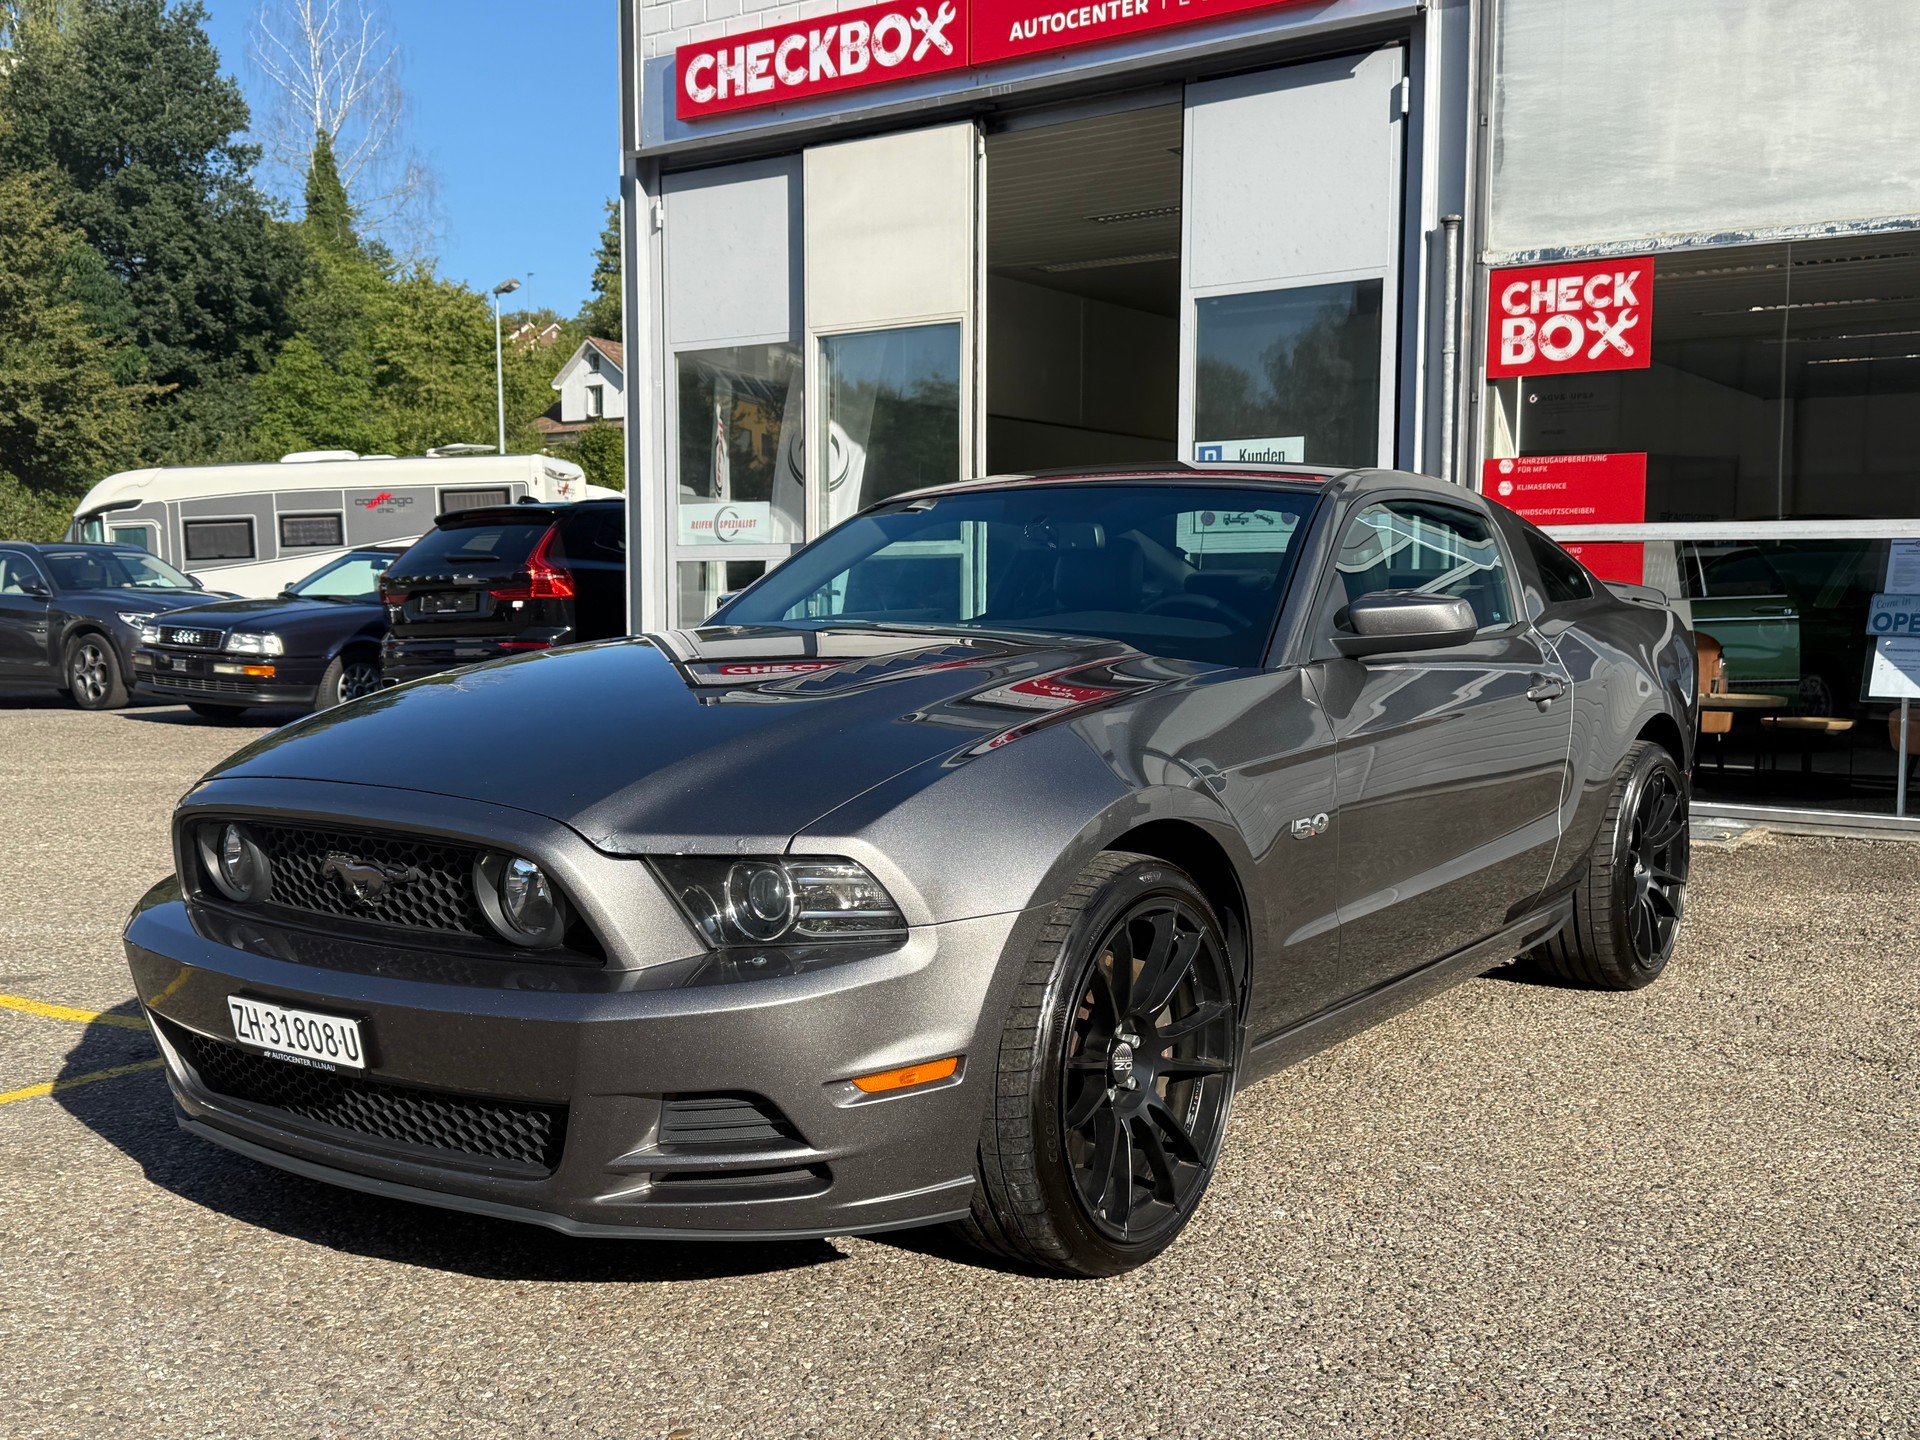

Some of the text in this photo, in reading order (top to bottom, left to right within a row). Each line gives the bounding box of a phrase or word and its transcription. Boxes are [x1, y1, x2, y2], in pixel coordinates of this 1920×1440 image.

[1008, 0, 1149, 41] AUTOCENTER
[684, 0, 957, 104] CHECKBOX
[1501, 270, 1641, 316] CHECK
[1501, 307, 1639, 366] BOX
[1239, 447, 1286, 462] Kunden
[1517, 454, 1608, 465] FAHRZEUGAUFBEREITUNG
[1532, 465, 1548, 473] MFK
[1516, 482, 1567, 491] KLIMASERVICE
[1515, 507, 1595, 516] WINDSCHUTZSCHEIBEN
[690, 519, 757, 529] REIFEN SPEZIALIST
[1876, 597, 1911, 609] Come in
[271, 1051, 336, 1072] AUTOCENTER ILLNAU
